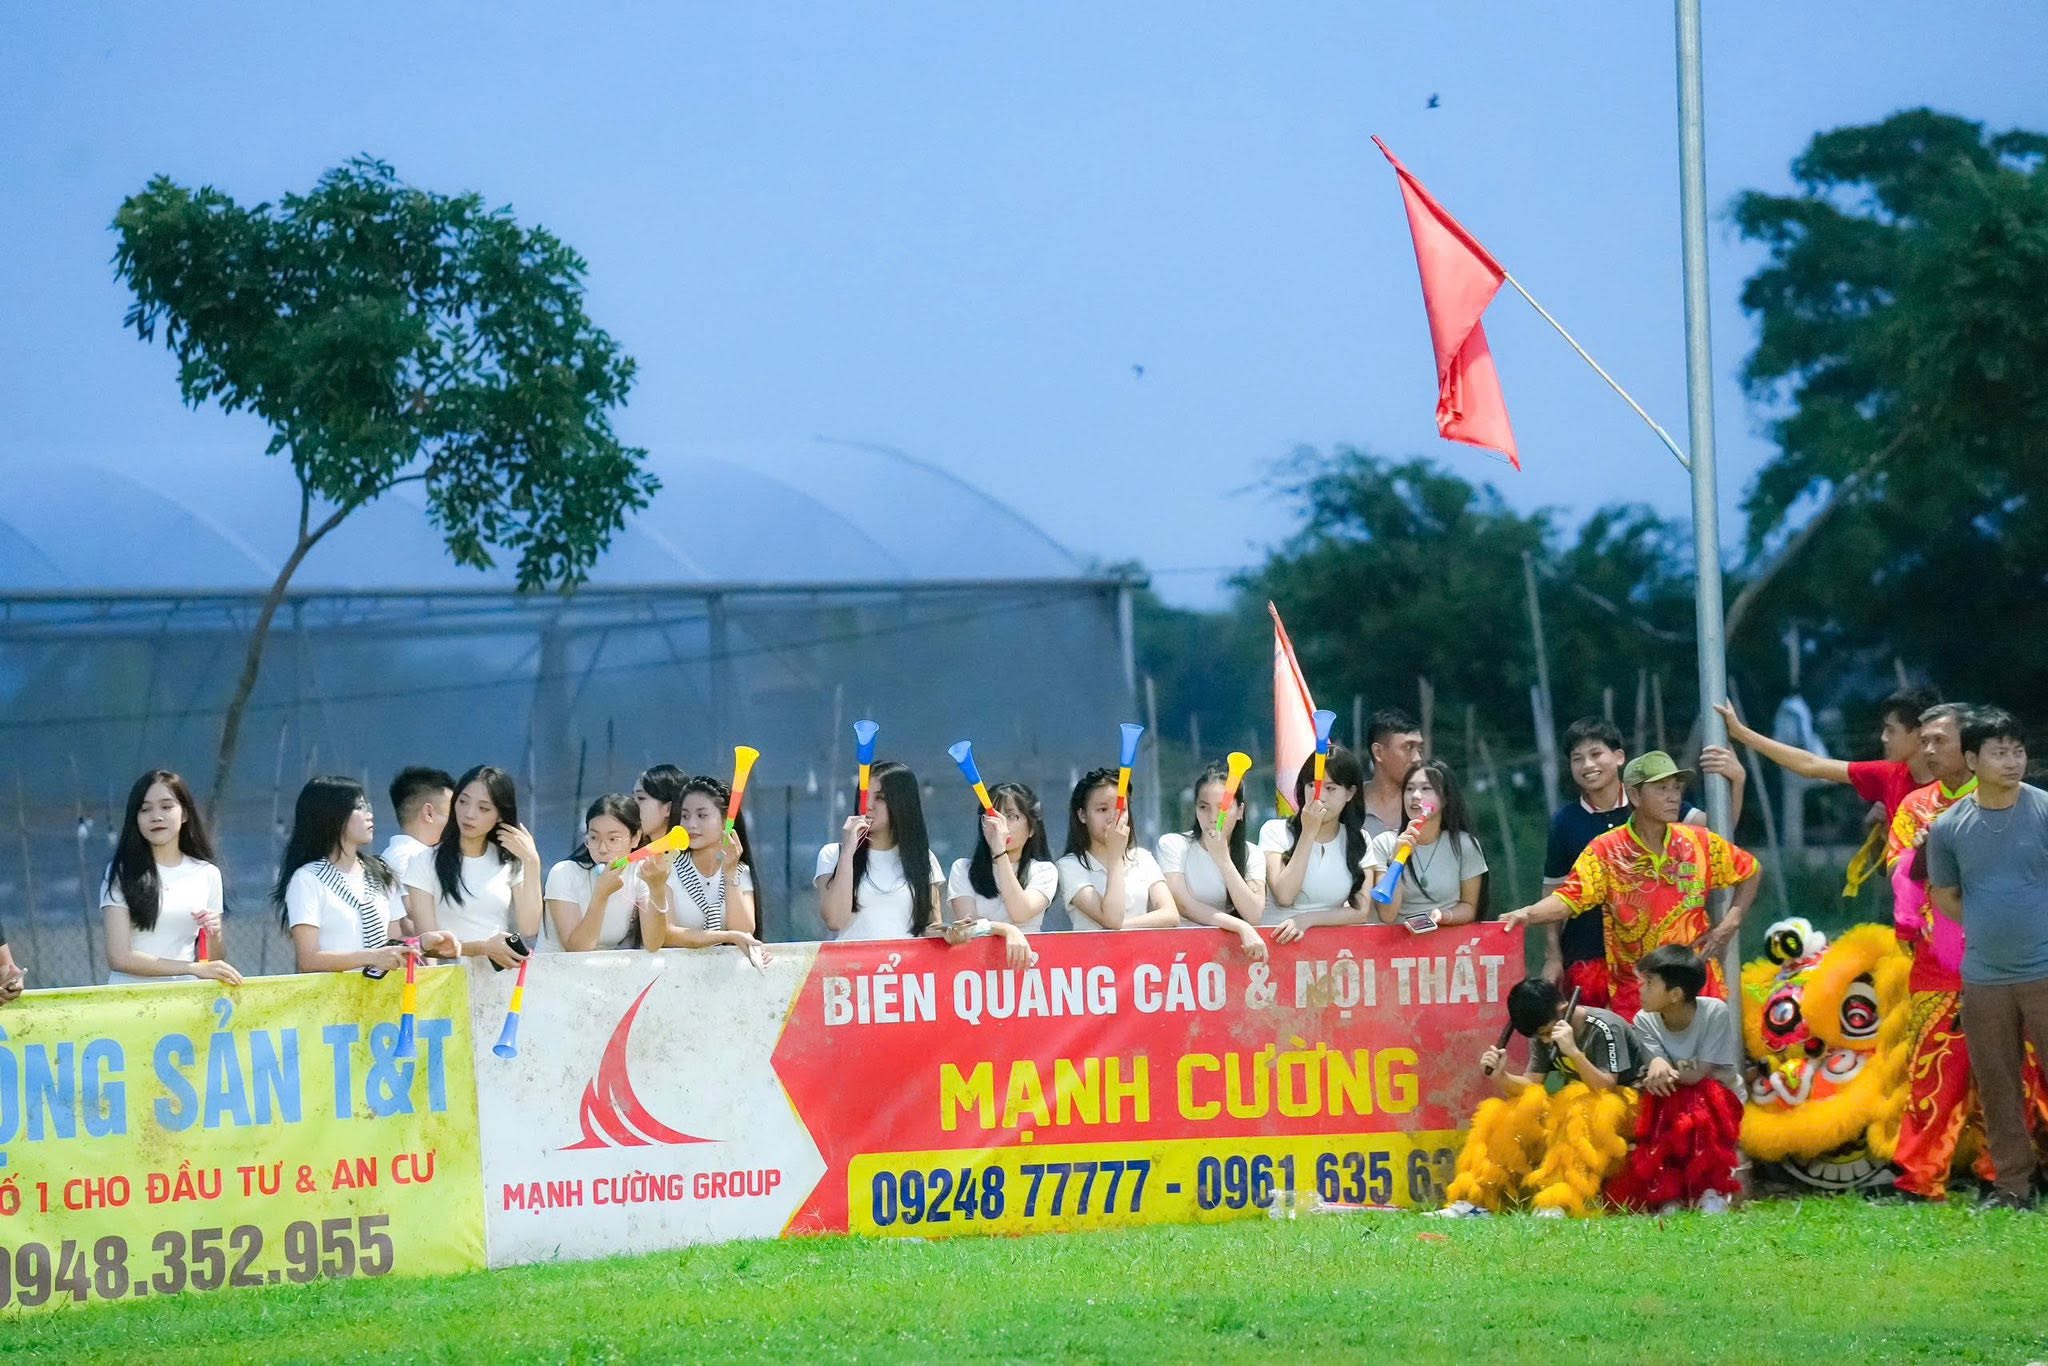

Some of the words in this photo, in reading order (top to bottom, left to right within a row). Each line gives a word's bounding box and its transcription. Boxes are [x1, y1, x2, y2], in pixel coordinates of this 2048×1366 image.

[822, 952, 937, 1026] BIỂN
[953, 951, 1117, 1025] QUẢNG
[1133, 952, 1226, 1013] CÁO
[1245, 961, 1278, 1010] &
[1295, 948, 1376, 1018] NỘI
[1391, 938, 1505, 1005] THẤT
[153, 998, 302, 1132] SẢN
[323, 1018, 452, 1119] T&T
[939, 1055, 1150, 1143] MẠNH
[1176, 1035, 1419, 1120] CƯỜNG
[36, 1182, 48, 1213] 1
[64, 1175, 130, 1211] CHO
[145, 1160, 221, 1204] ĐẦU
[237, 1161, 283, 1197] TƯ
[296, 1165, 317, 1192] &
[331, 1157, 378, 1190] AN
[391, 1149, 436, 1184] CƯ
[503, 1179, 583, 1215] MẠNH
[593, 1169, 684, 1206] CƯỜNG
[693, 1169, 781, 1200] GROUP
[871, 1164, 1006, 1226] 09248
[1020, 1159, 1151, 1217] 77777
[1166, 1182, 1181, 1194] -
[1197, 1154, 1295, 1210] 0961
[1315, 1151, 1392, 1206] 635
